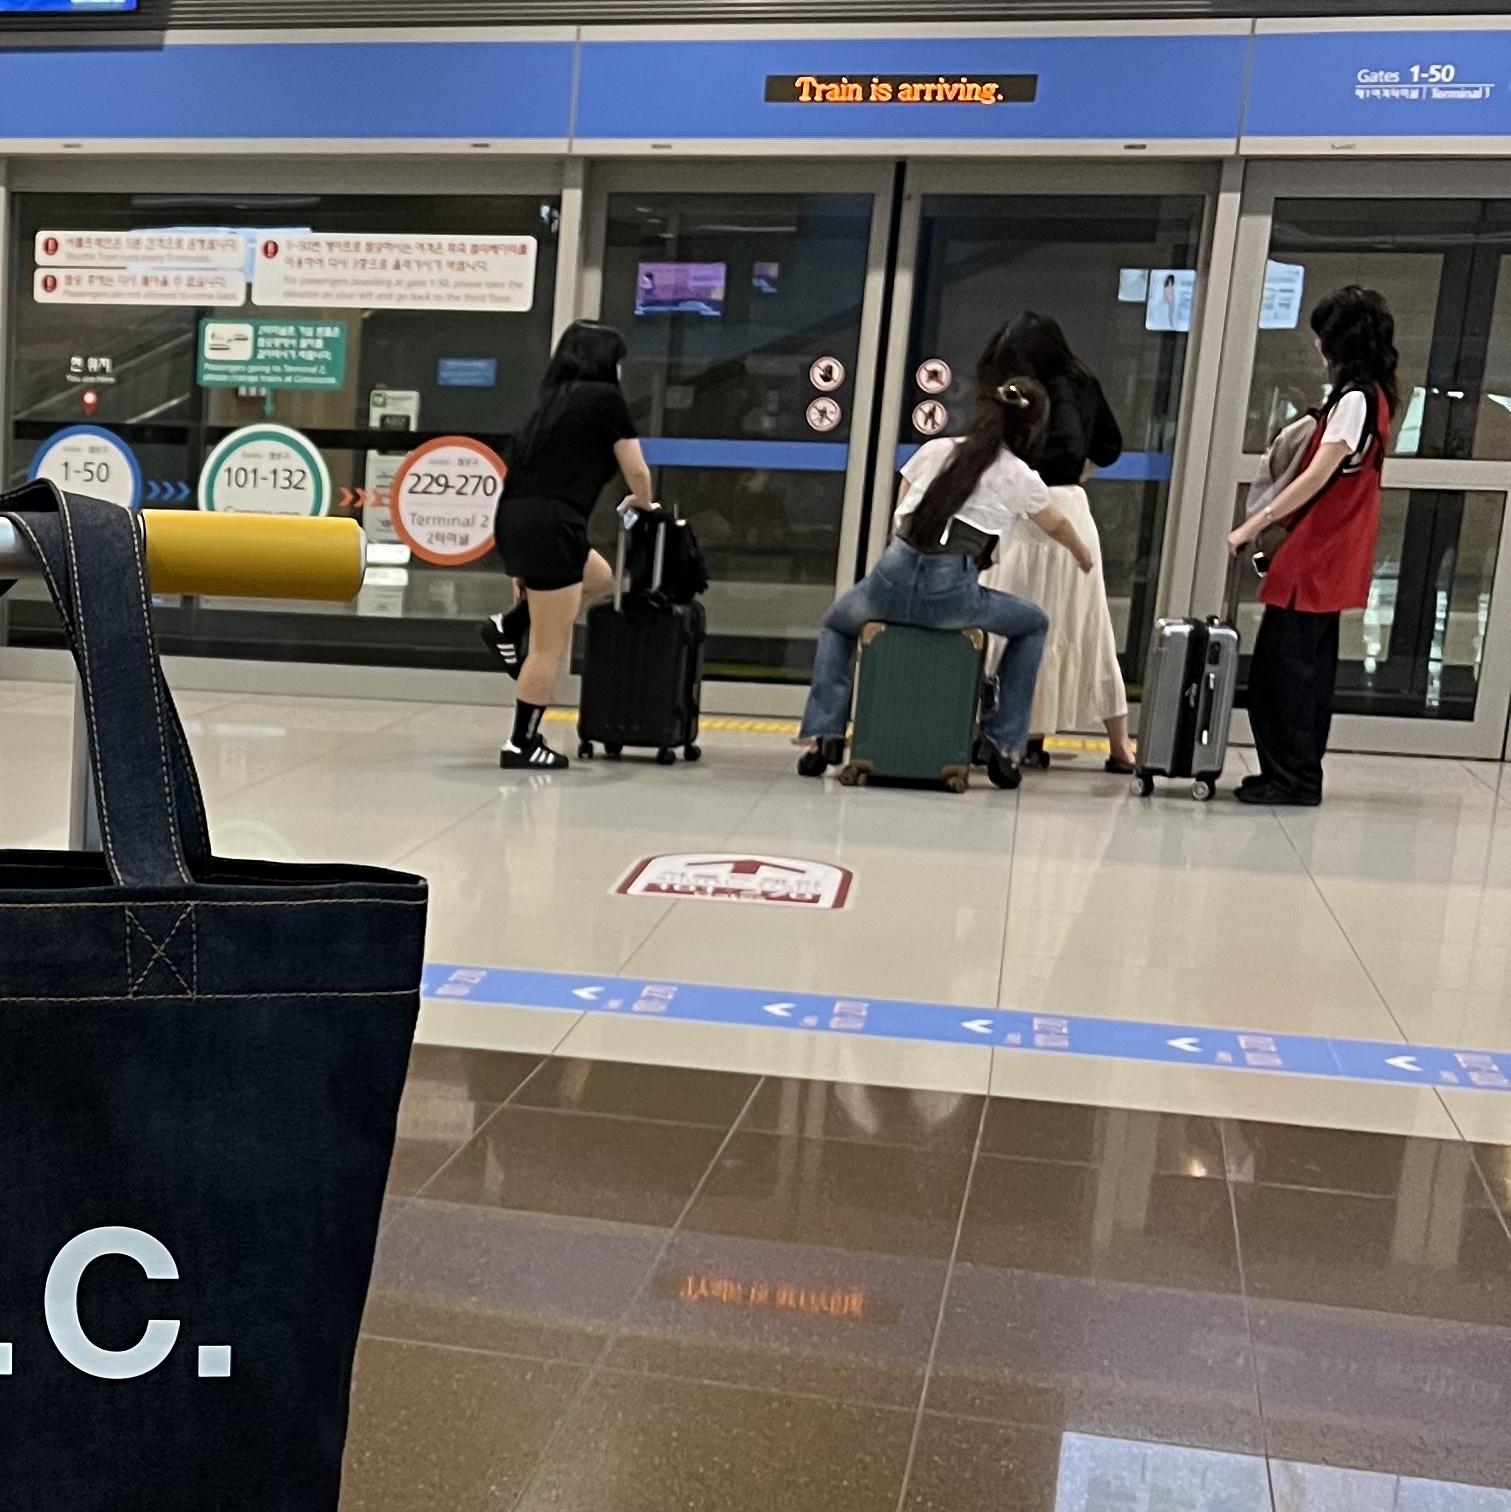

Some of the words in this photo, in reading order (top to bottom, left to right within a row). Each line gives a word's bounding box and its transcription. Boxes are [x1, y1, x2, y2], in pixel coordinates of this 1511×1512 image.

[1357, 69, 1400, 83] Gates
[1410, 64, 1455, 83] 1-50
[795, 76, 863, 102] Train
[869, 77, 892, 101] is
[898, 76, 1004, 105] arriving.
[61, 461, 110, 483] 1-50
[224, 466, 307, 491] 101-132
[407, 473, 498, 497] 229-270
[409, 511, 476, 528] Terminal
[479, 514, 490, 529] 2
